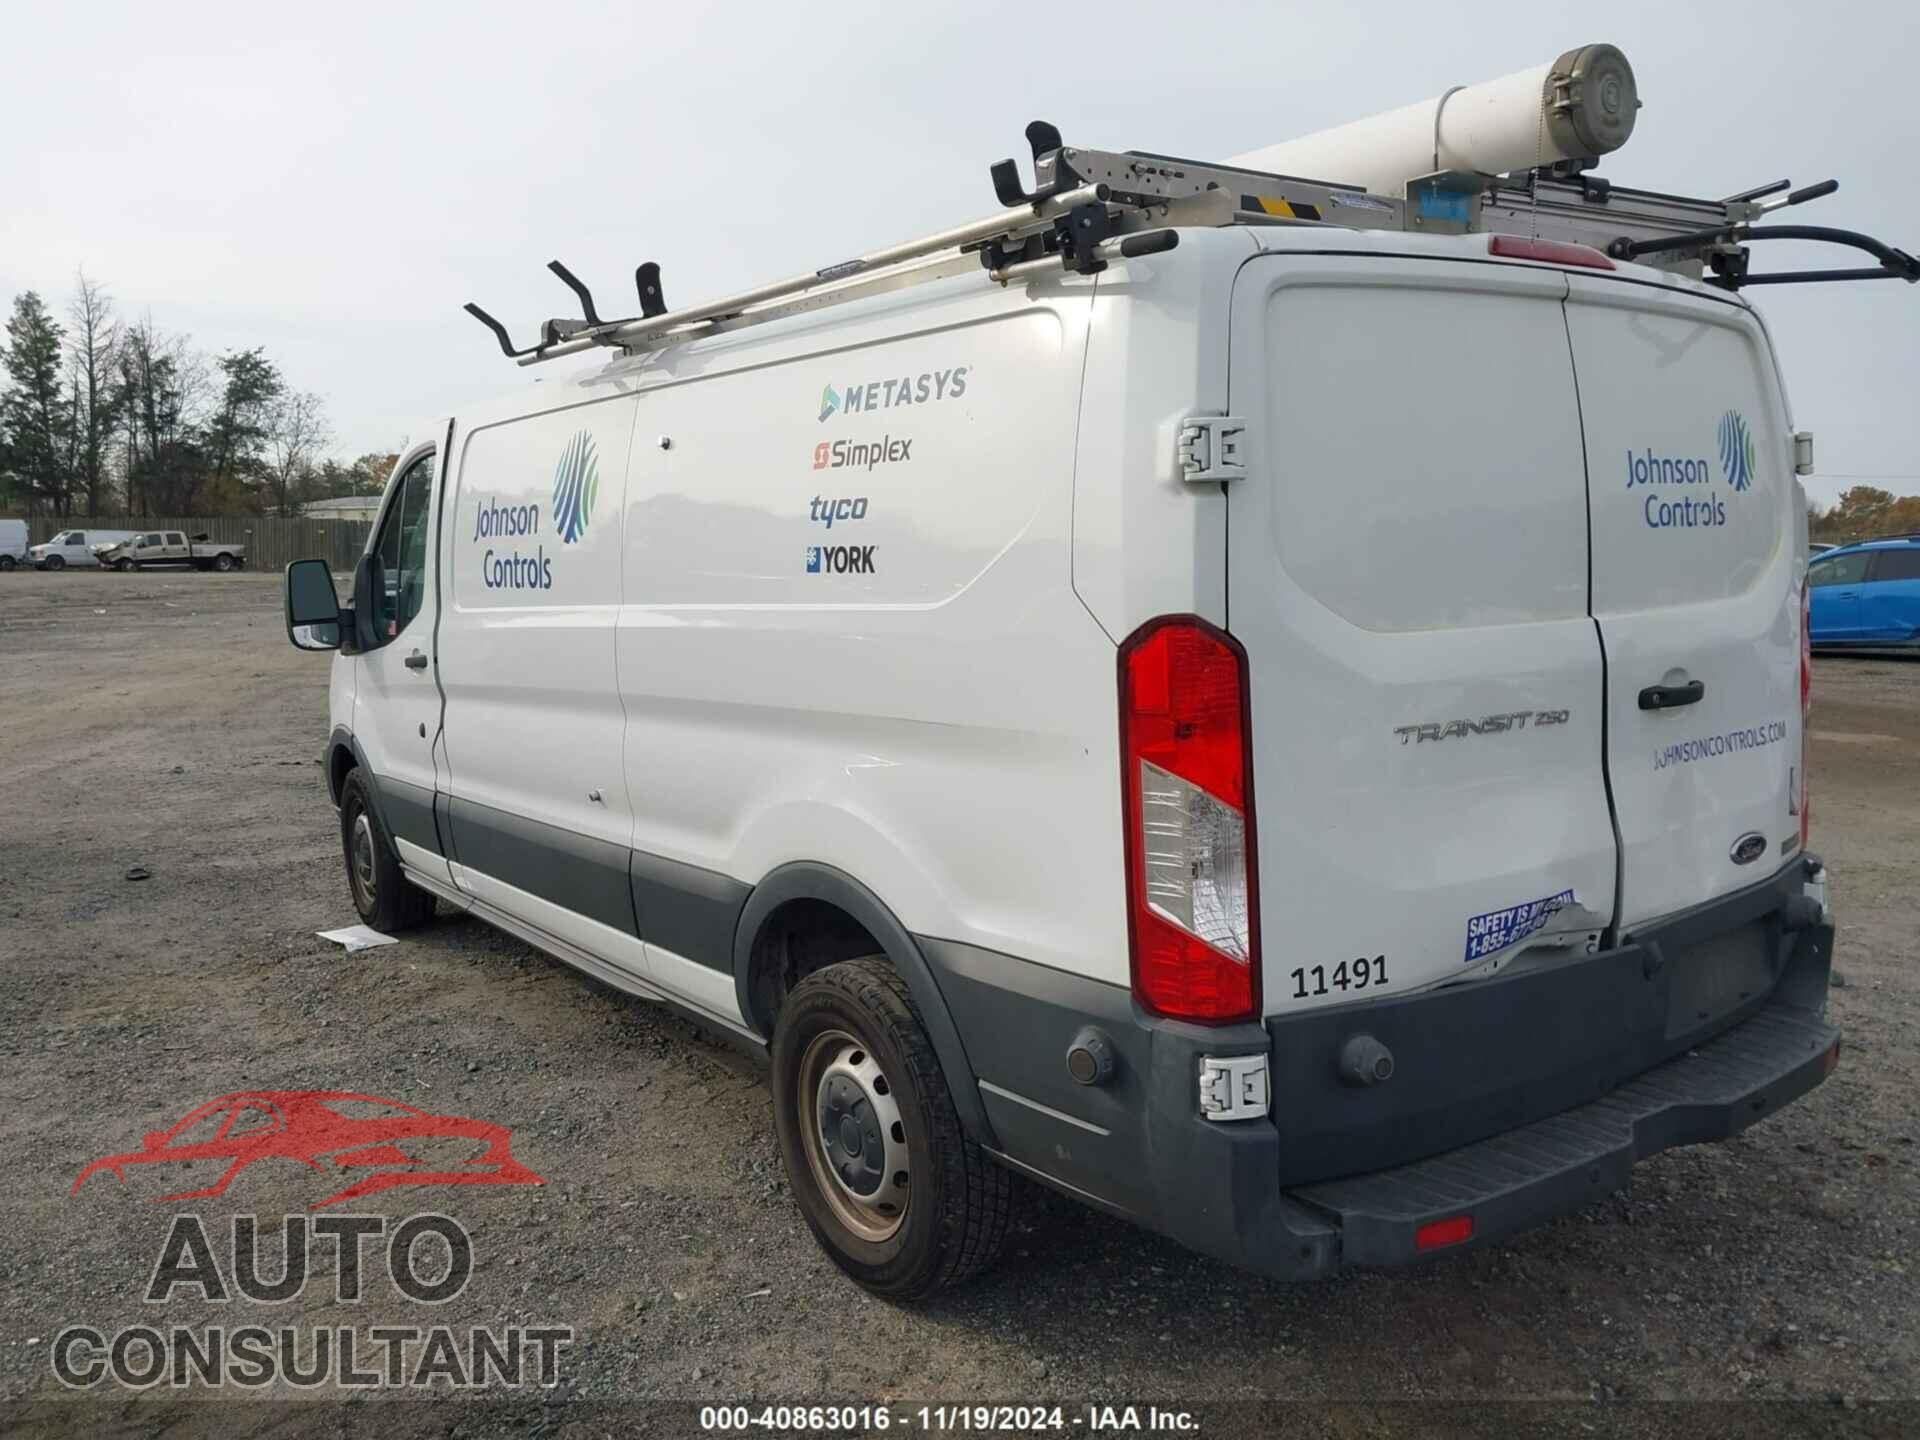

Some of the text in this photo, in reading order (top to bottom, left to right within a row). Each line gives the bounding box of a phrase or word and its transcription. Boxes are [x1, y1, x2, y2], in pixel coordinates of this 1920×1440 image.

[844, 367, 968, 414] METASYS
[831, 435, 912, 472] Simplex
[1627, 448, 1709, 488] Johnson
[473, 496, 539, 544] Johnson
[810, 495, 868, 529] tyco
[1645, 491, 1726, 528] Controls
[484, 544, 552, 589] Controls
[823, 545, 876, 573] YORK
[1393, 711, 1533, 744] TRANSIT
[1654, 720, 1786, 770] JOHNSONCONTROLS.COM
[1469, 909, 1517, 938] SAFETY
[1516, 905, 1529, 923] IS
[1290, 954, 1389, 998] 11491
